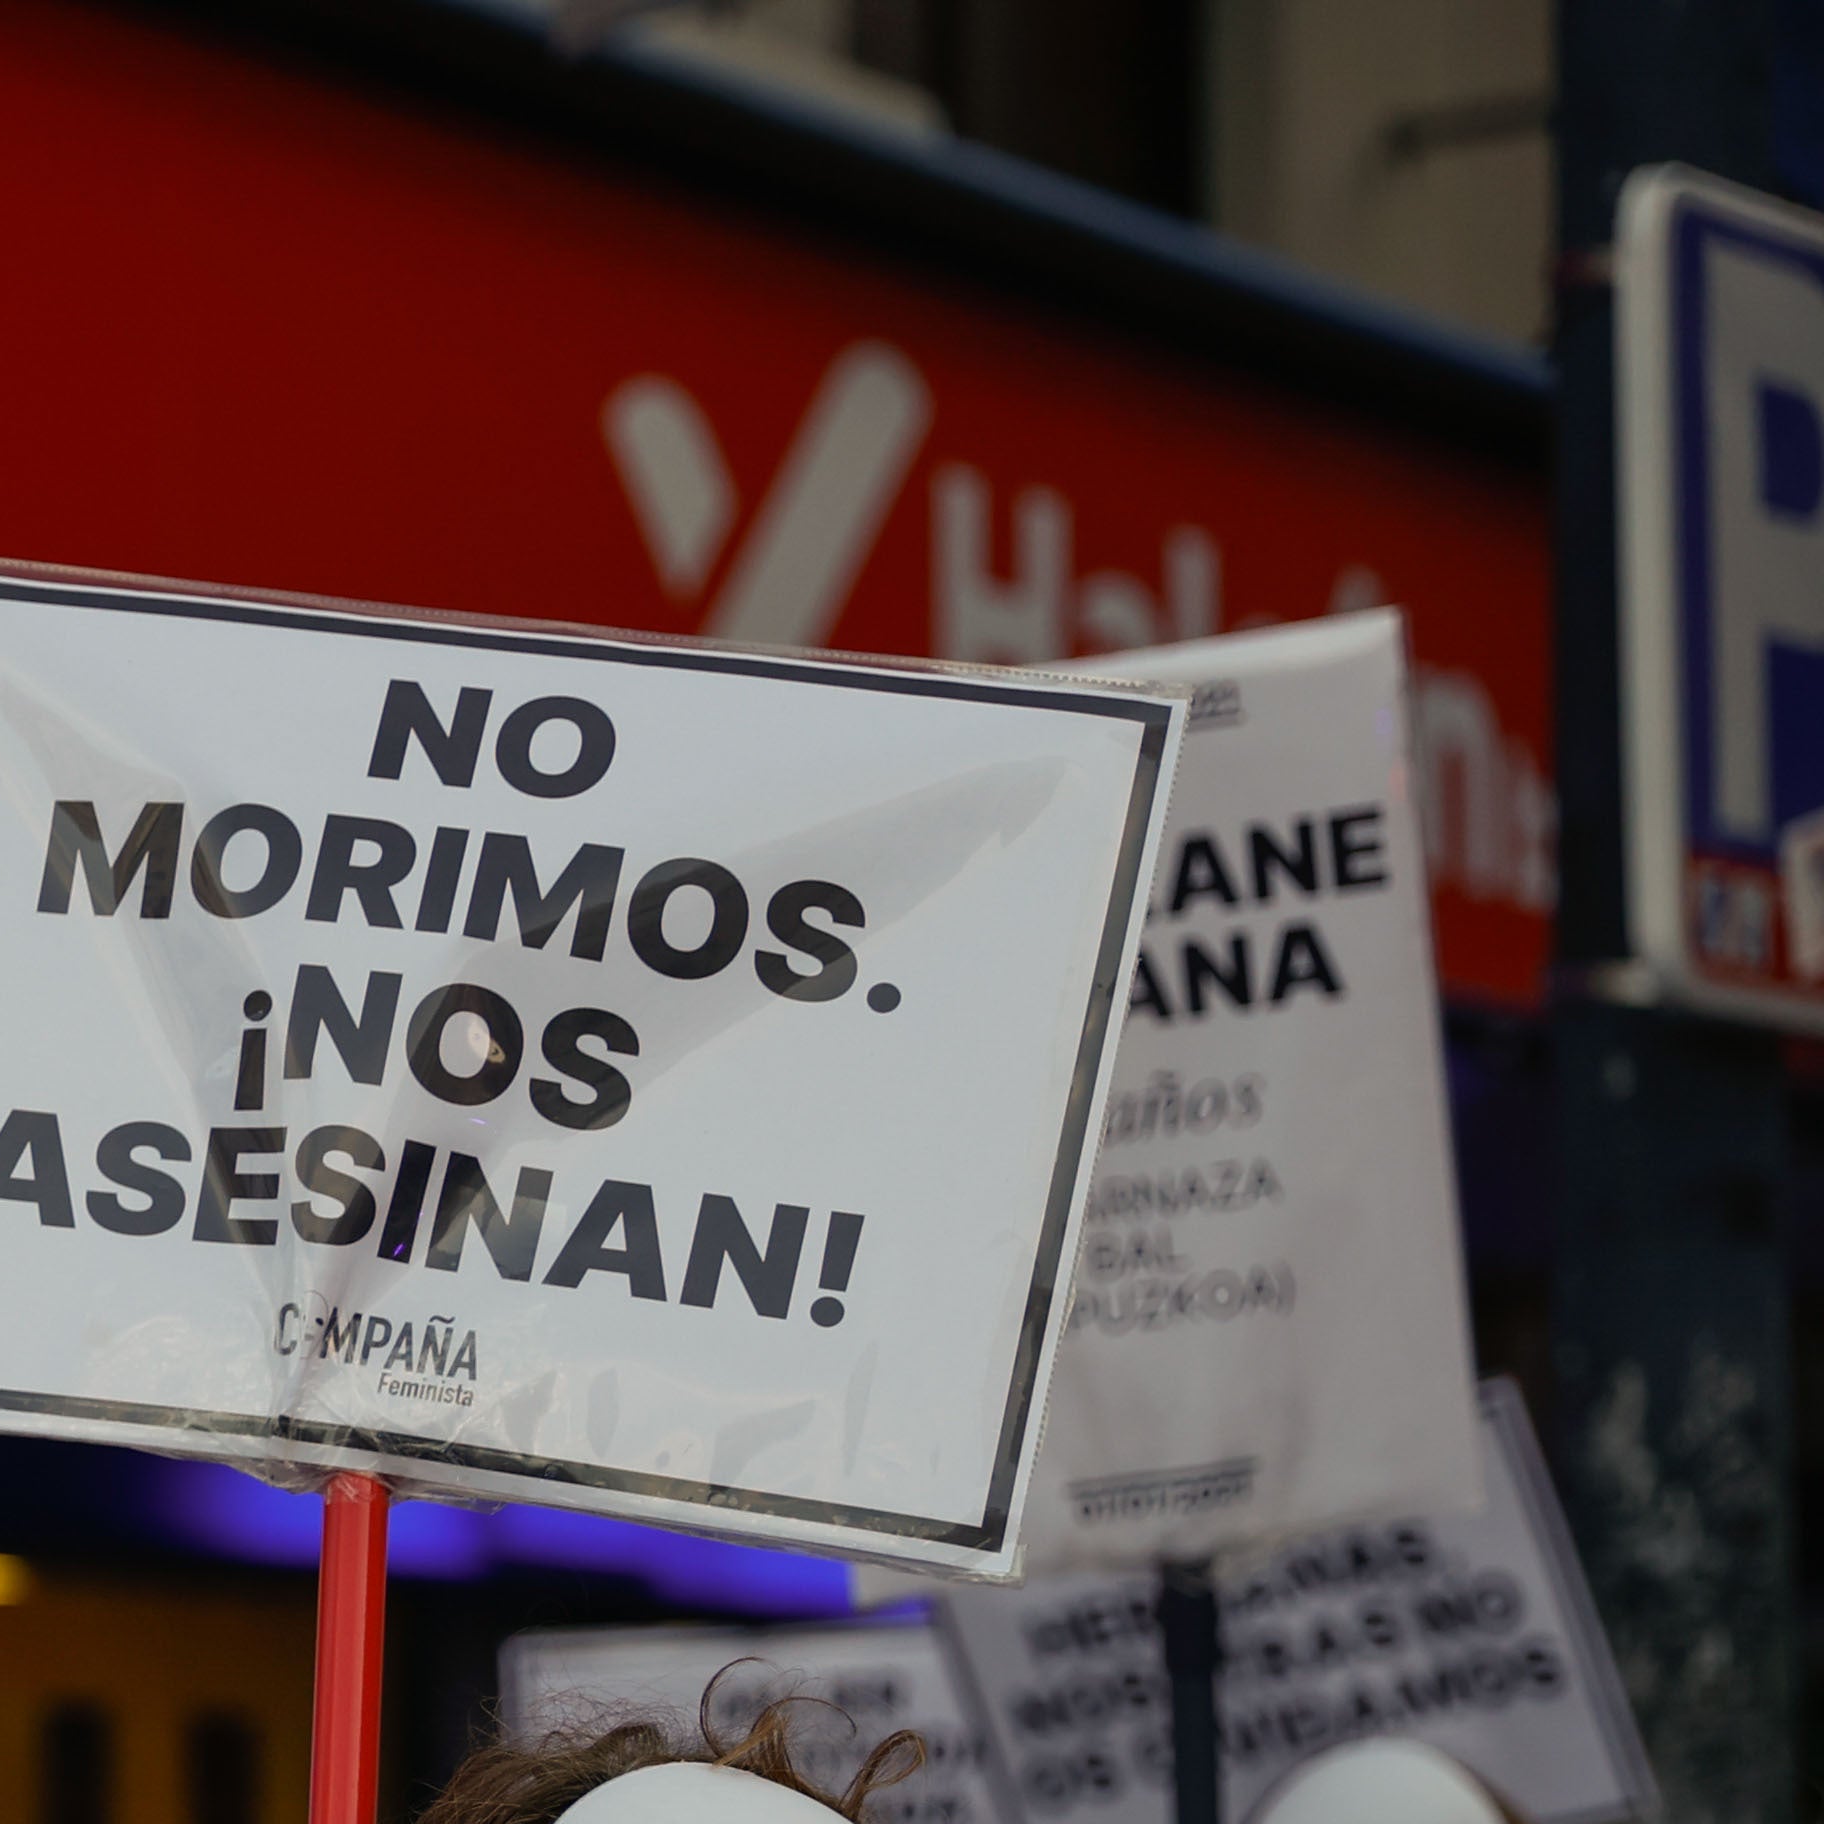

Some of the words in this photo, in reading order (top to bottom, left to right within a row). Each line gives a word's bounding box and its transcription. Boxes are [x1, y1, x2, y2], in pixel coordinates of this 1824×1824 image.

[366, 678, 616, 799] NO
[35, 799, 902, 1015] MORIMOS.
[1145, 803, 1388, 922] ANE
[232, 963, 640, 1132] ¡NOS
[274, 1300, 478, 1381] CMPAÑA
[377, 1372, 475, 1407] Feminista
